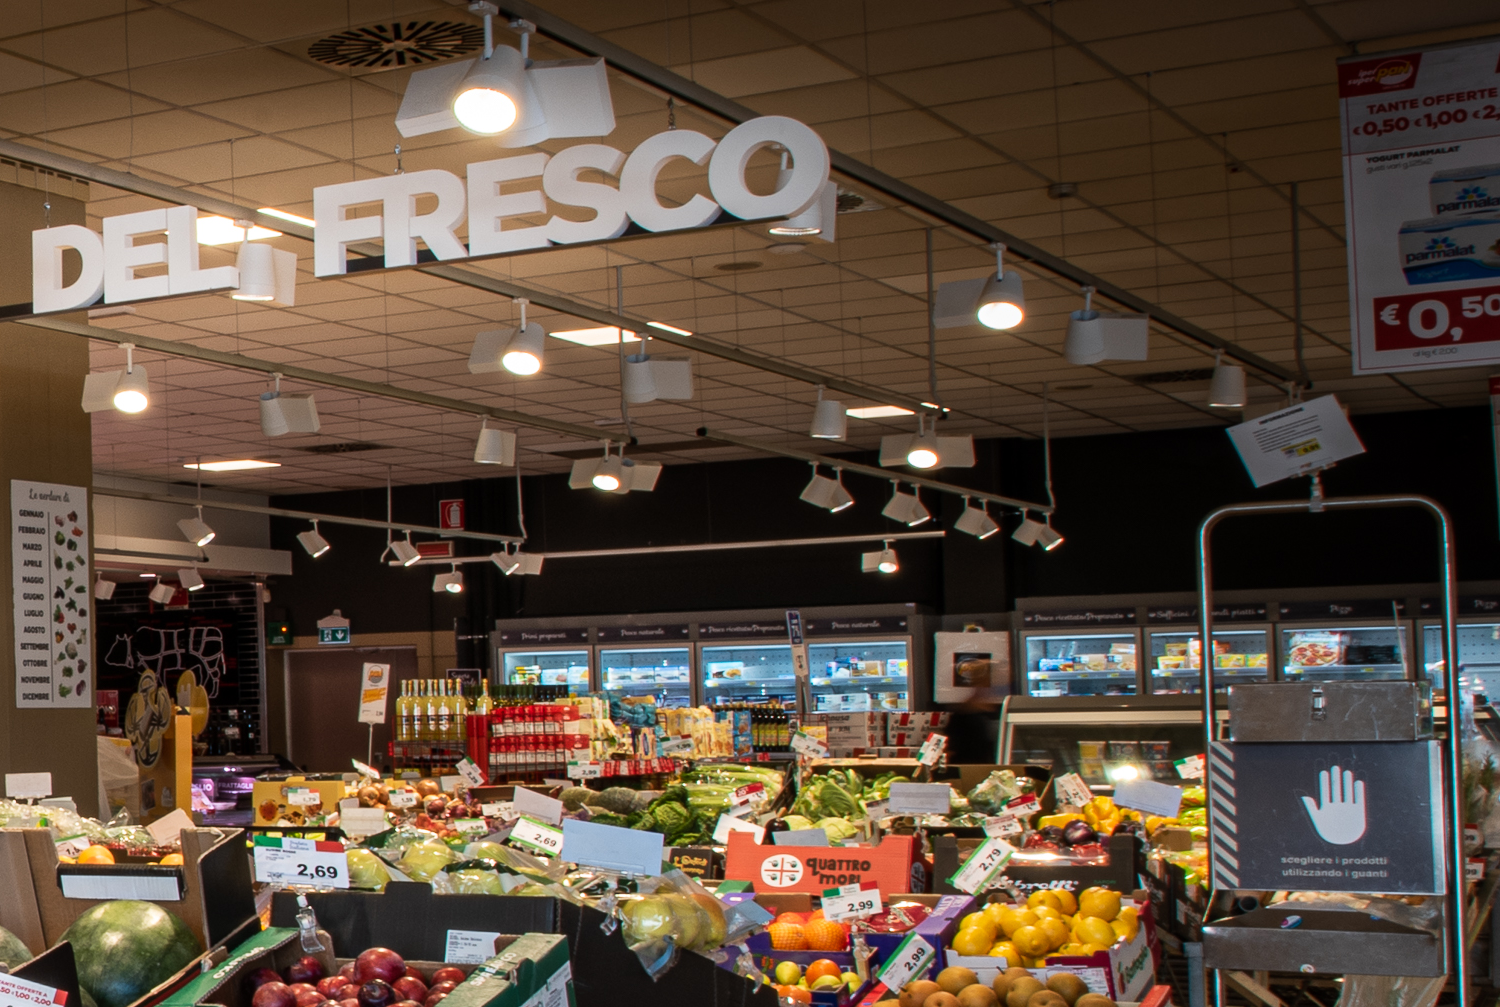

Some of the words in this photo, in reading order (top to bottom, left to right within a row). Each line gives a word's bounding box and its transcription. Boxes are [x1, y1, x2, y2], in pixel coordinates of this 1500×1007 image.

[1366, 99, 1419, 115] TANTE
[1421, 87, 1498, 108] OFFERTE
[1366, 152, 1406, 164] YOGURT
[1406, 145, 1461, 160] PARMALAT
[32, 205, 242, 314] DEL
[313, 114, 833, 279] FRESCO
[1405, 244, 1476, 264] parmalat
[534, 832, 558, 848] 2,69
[979, 847, 1002, 872] 2,79
[1280, 856, 1332, 867] scegliere
[1342, 855, 1388, 869] prodotti
[296, 863, 338, 879] 2,69
[1281, 868, 1342, 878] utilizzando
[1351, 868, 1388, 881] guanti
[847, 899, 874, 913] 2,99
[904, 946, 927, 970] 2,99
